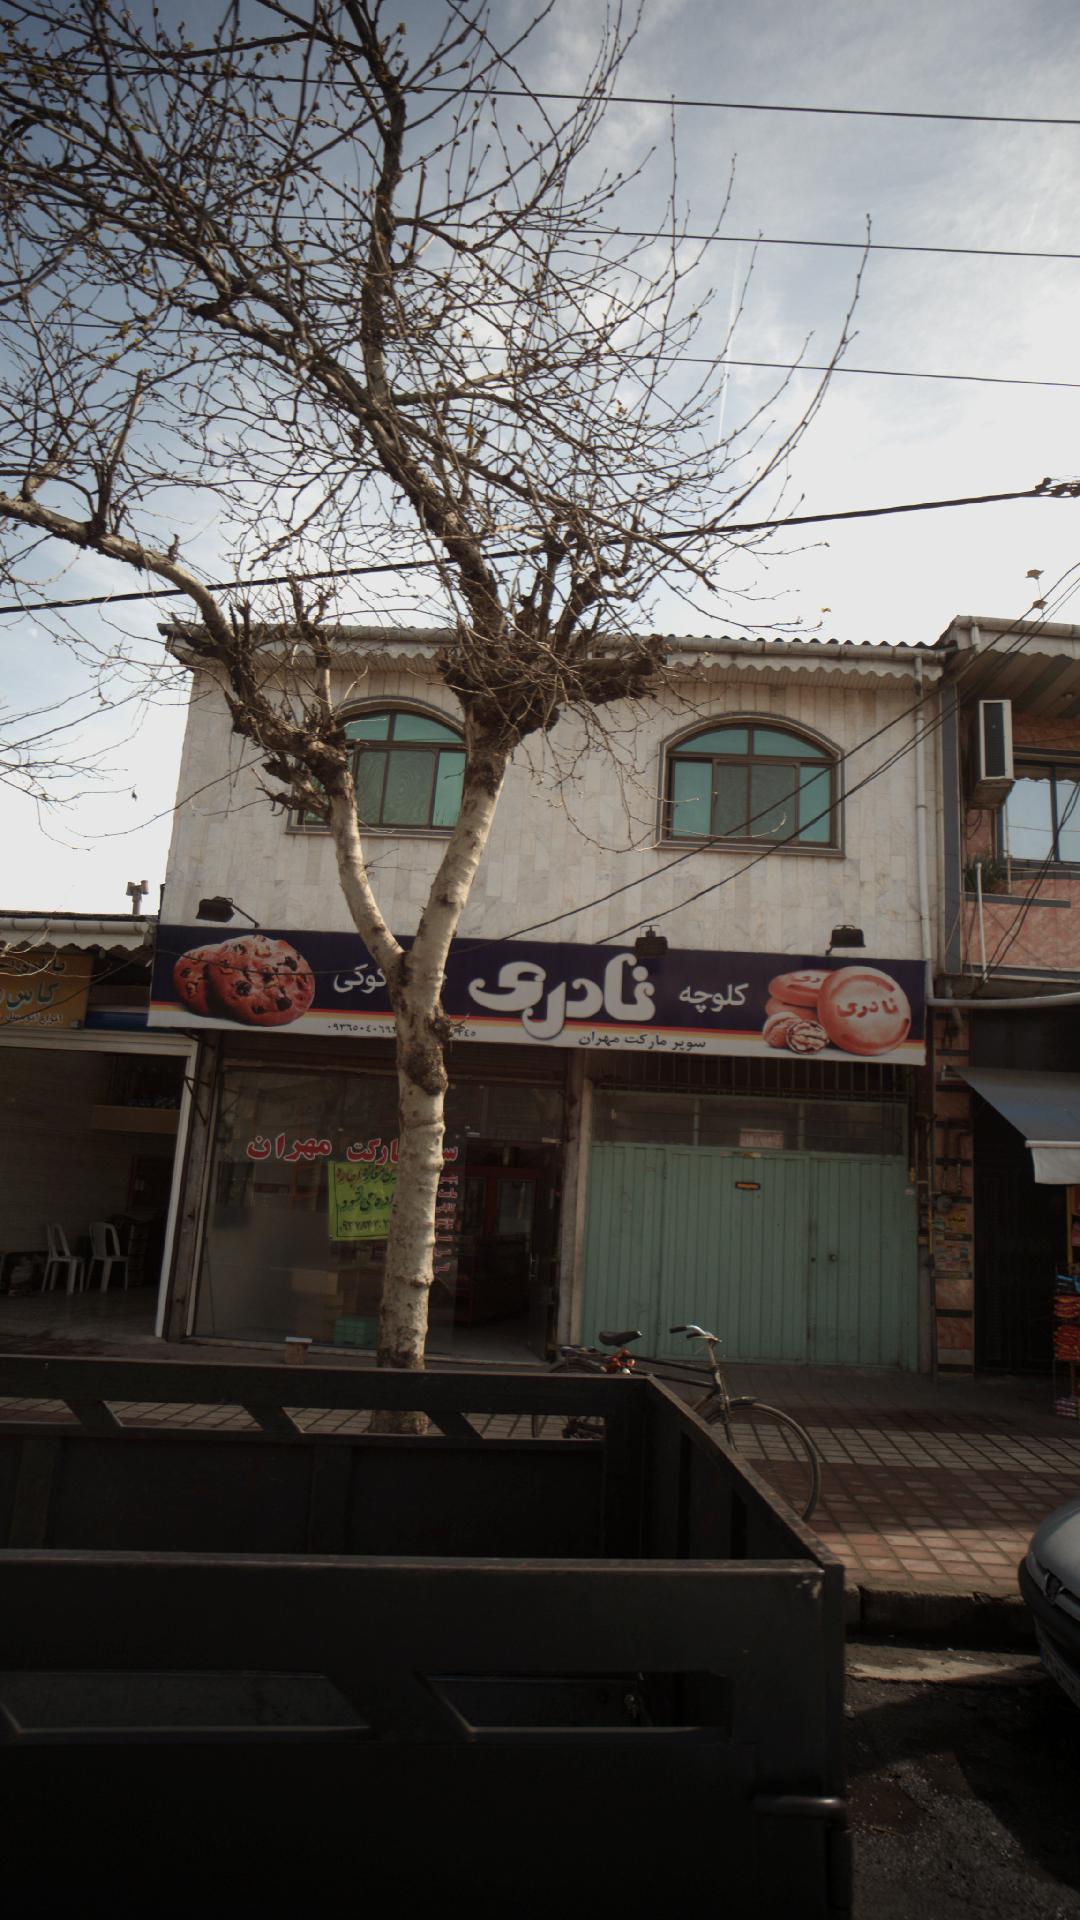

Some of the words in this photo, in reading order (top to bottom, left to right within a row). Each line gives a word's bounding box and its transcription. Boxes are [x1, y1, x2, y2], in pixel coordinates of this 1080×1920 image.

[468, 953, 656, 1041] نادری
[679, 984, 750, 1014] کلوچه
[836, 998, 899, 1019] نادری
[577, 1031, 620, 1047] مهران
[624, 1033, 668, 1050] مارکت
[671, 1039, 707, 1052] سوپر
[246, 1132, 333, 1162] مهران
[346, 1136, 399, 1166] ارکت
